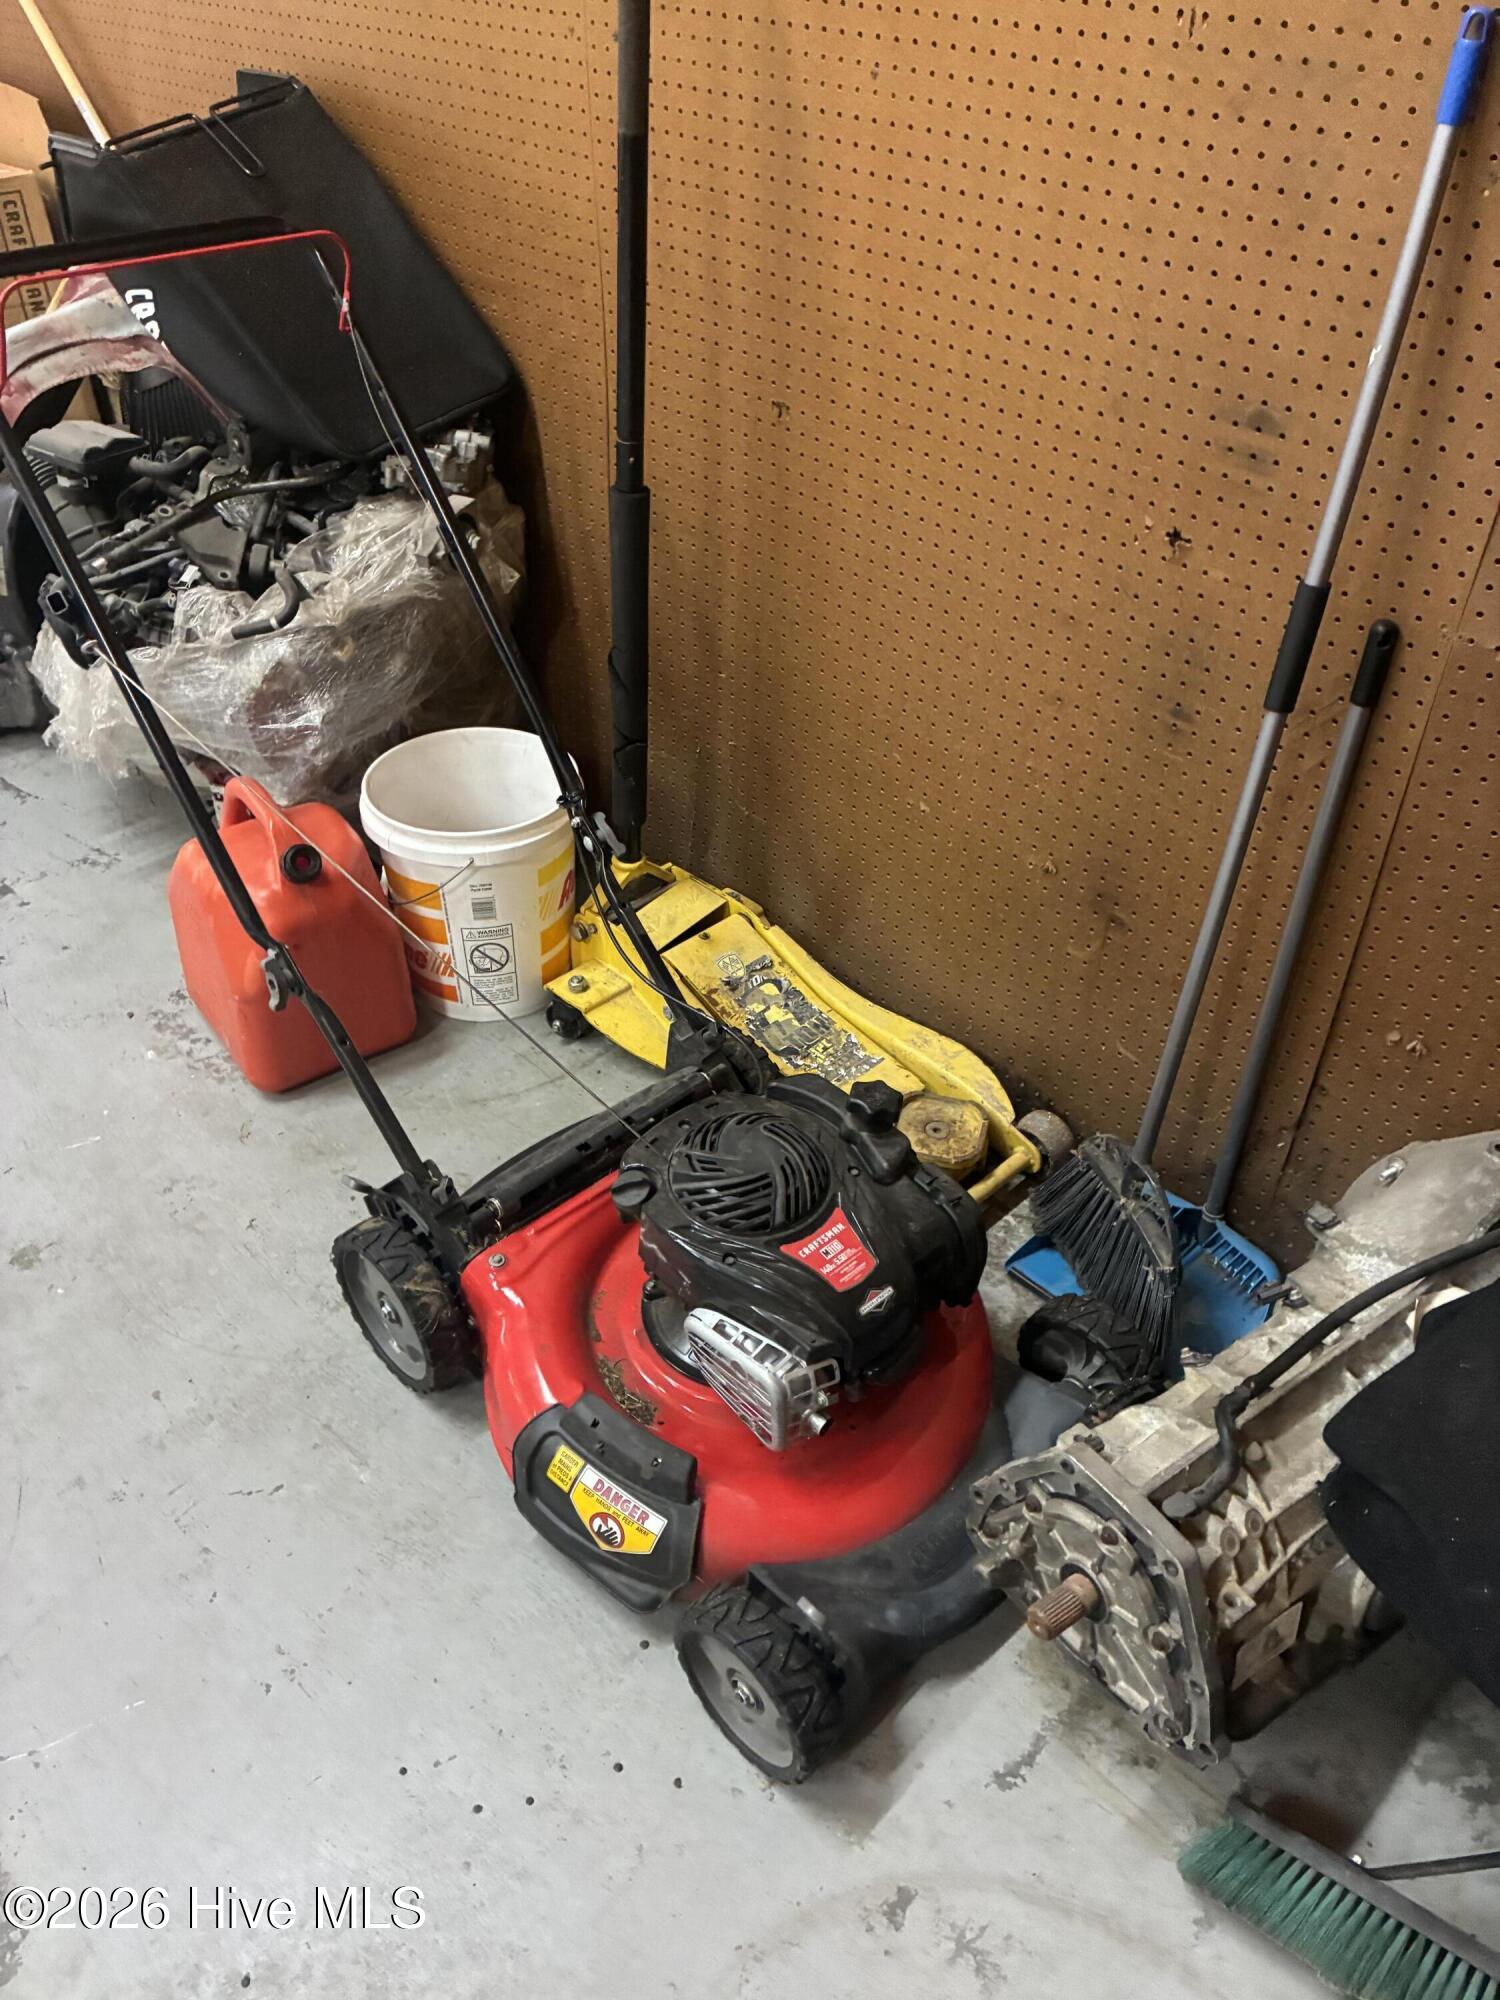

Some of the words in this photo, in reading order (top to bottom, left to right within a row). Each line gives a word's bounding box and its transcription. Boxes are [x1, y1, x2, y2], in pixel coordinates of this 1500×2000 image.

[3, 200, 46, 314] CRAFAN
[477, 927, 509, 935] WARNING
[798, 1222, 846, 1258] CRAFTSMAN
[583, 1487, 595, 1499] KEEP
[595, 1497, 612, 1512] HANDS
[621, 1515, 635, 1528] FEET
[635, 1526, 650, 1537] AWAY
[592, 1478, 650, 1526] DANGER
